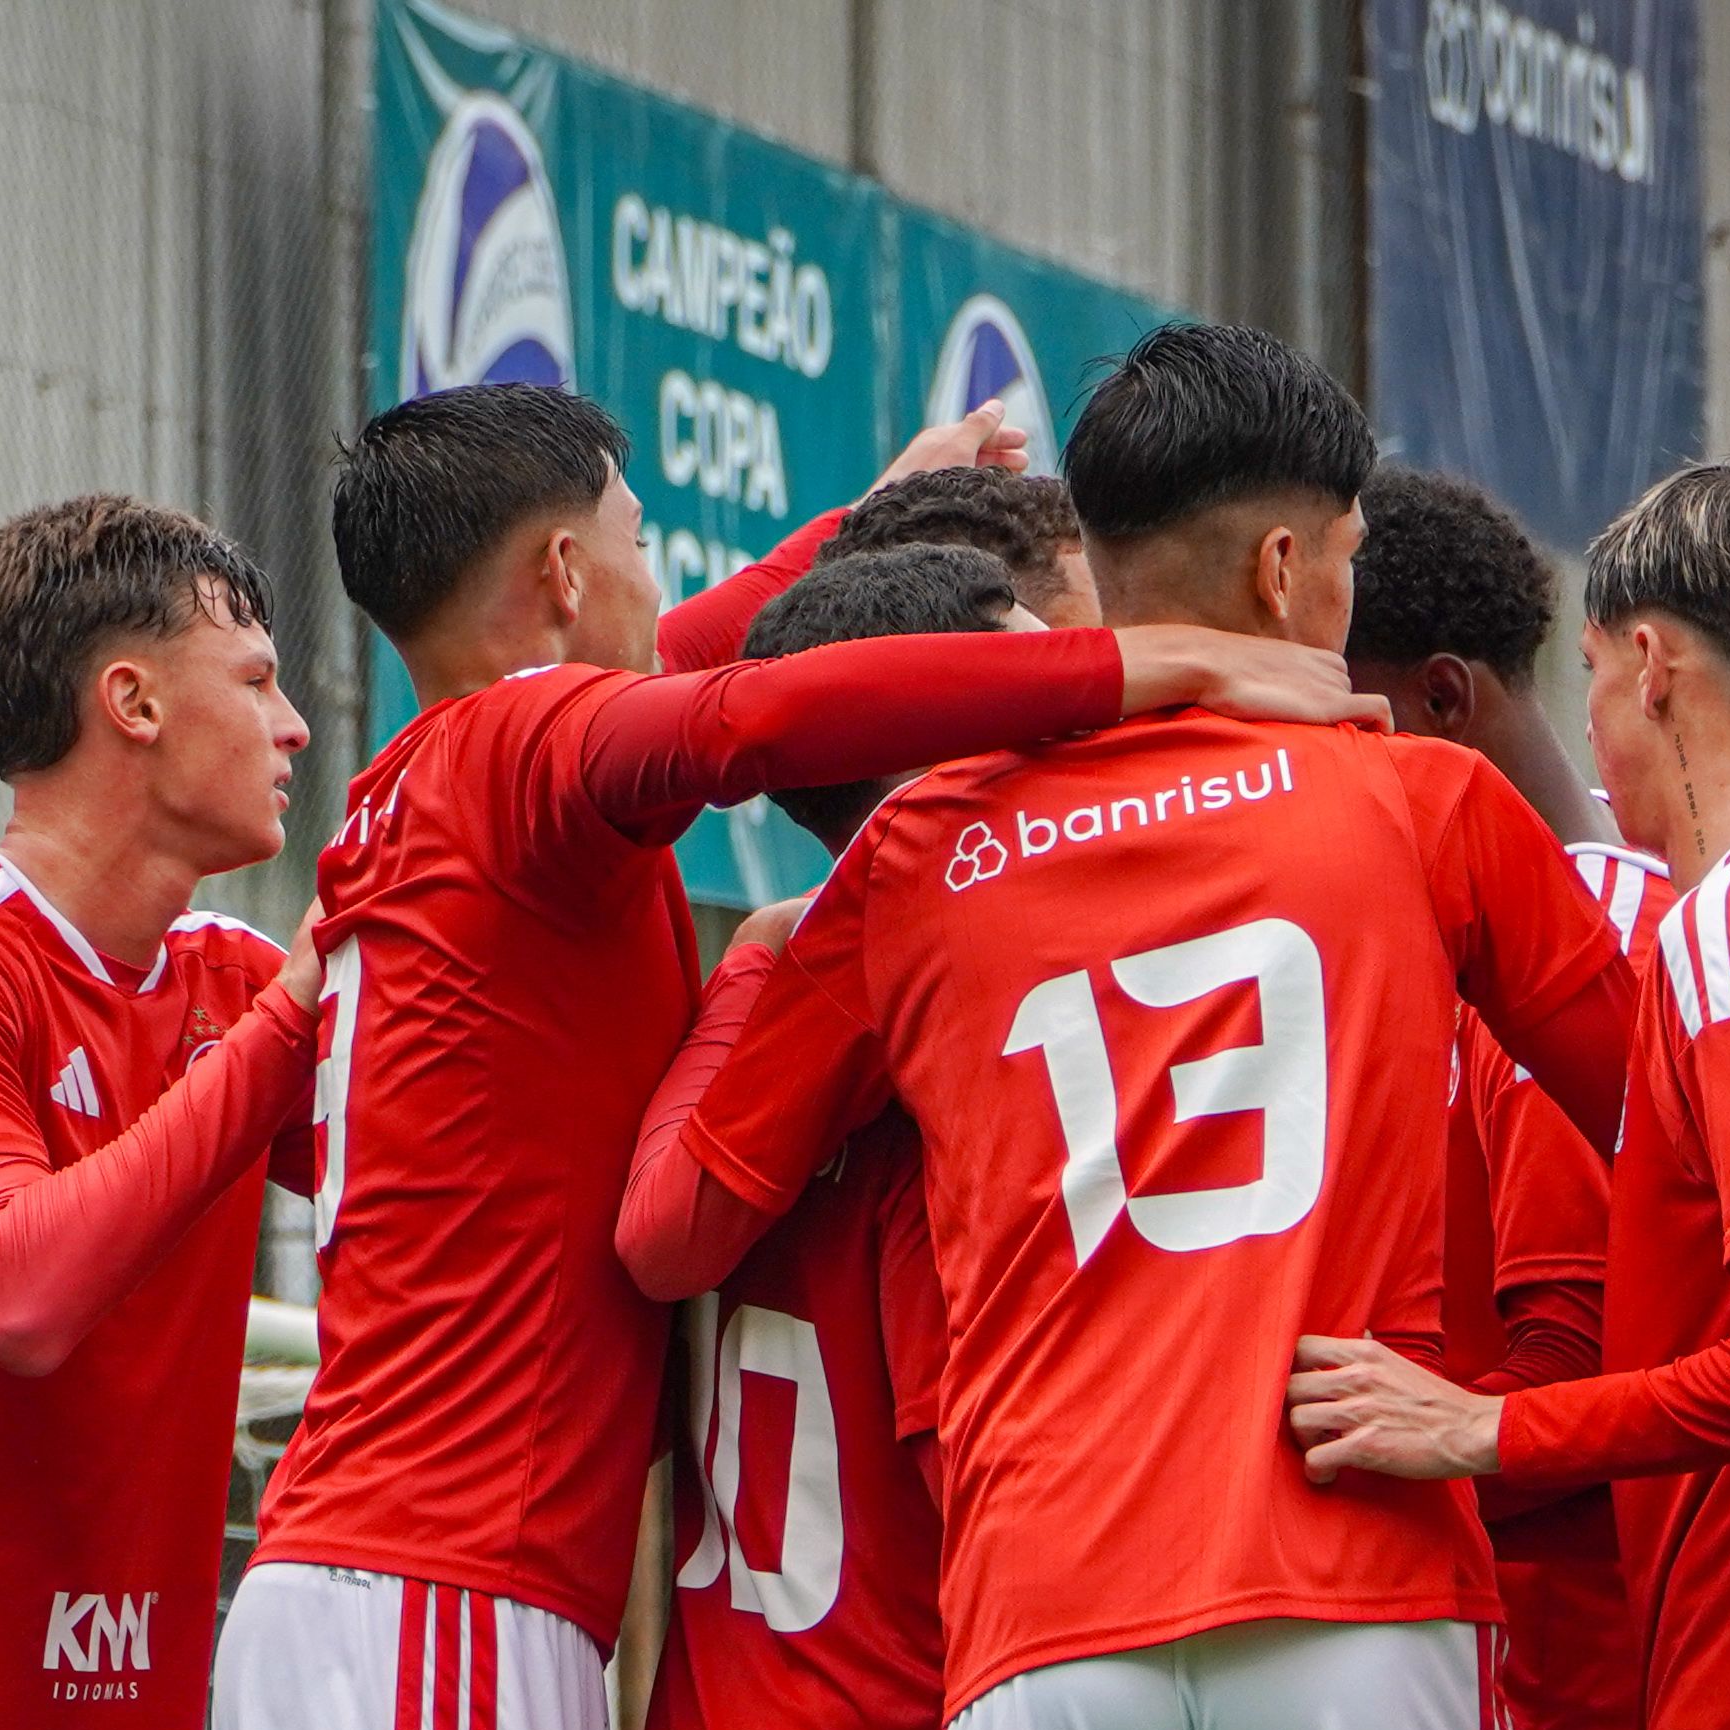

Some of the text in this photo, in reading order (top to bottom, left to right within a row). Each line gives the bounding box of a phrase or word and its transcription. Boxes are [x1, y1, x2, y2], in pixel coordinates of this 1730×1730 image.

[612, 190, 834, 379] CAMPEÃO
[659, 368, 789, 520] COPA
[1016, 748, 1294, 858] banrisul
[1002, 918, 1328, 1269] 13
[52, 1681, 139, 1701] IDIOMAS
